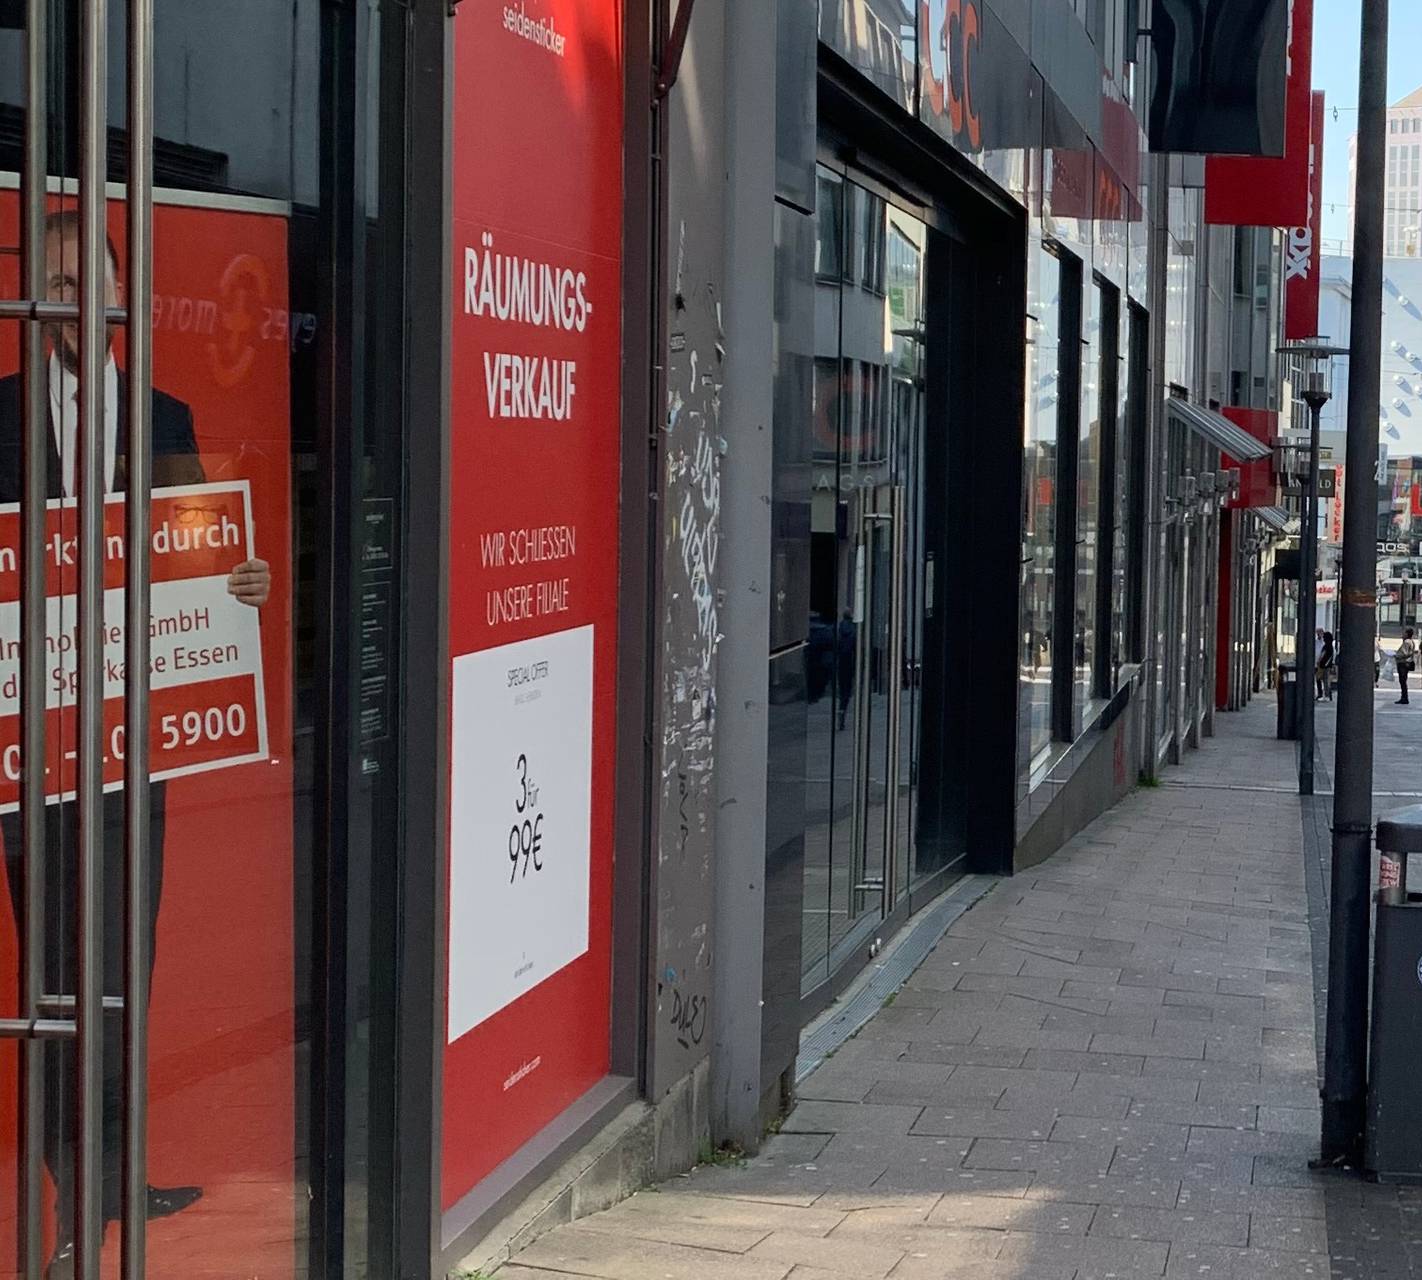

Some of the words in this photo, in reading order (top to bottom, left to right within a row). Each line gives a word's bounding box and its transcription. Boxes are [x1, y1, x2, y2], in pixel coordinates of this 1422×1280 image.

[503, 2, 565, 57] seidensticker
[464, 231, 593, 333] RÄUMUNGS-
[483, 351, 576, 421] VERKAUF
[153, 515, 239, 554] durch
[480, 531, 505, 569] WIR
[509, 525, 576, 566] SCHLIESSEN
[487, 583, 533, 626] UNSERE
[536, 578, 569, 616] FILIALE
[174, 643, 239, 670] Essen
[161, 703, 246, 750] 5900
[515, 753, 527, 813] 3
[508, 812, 544, 884] 99€
